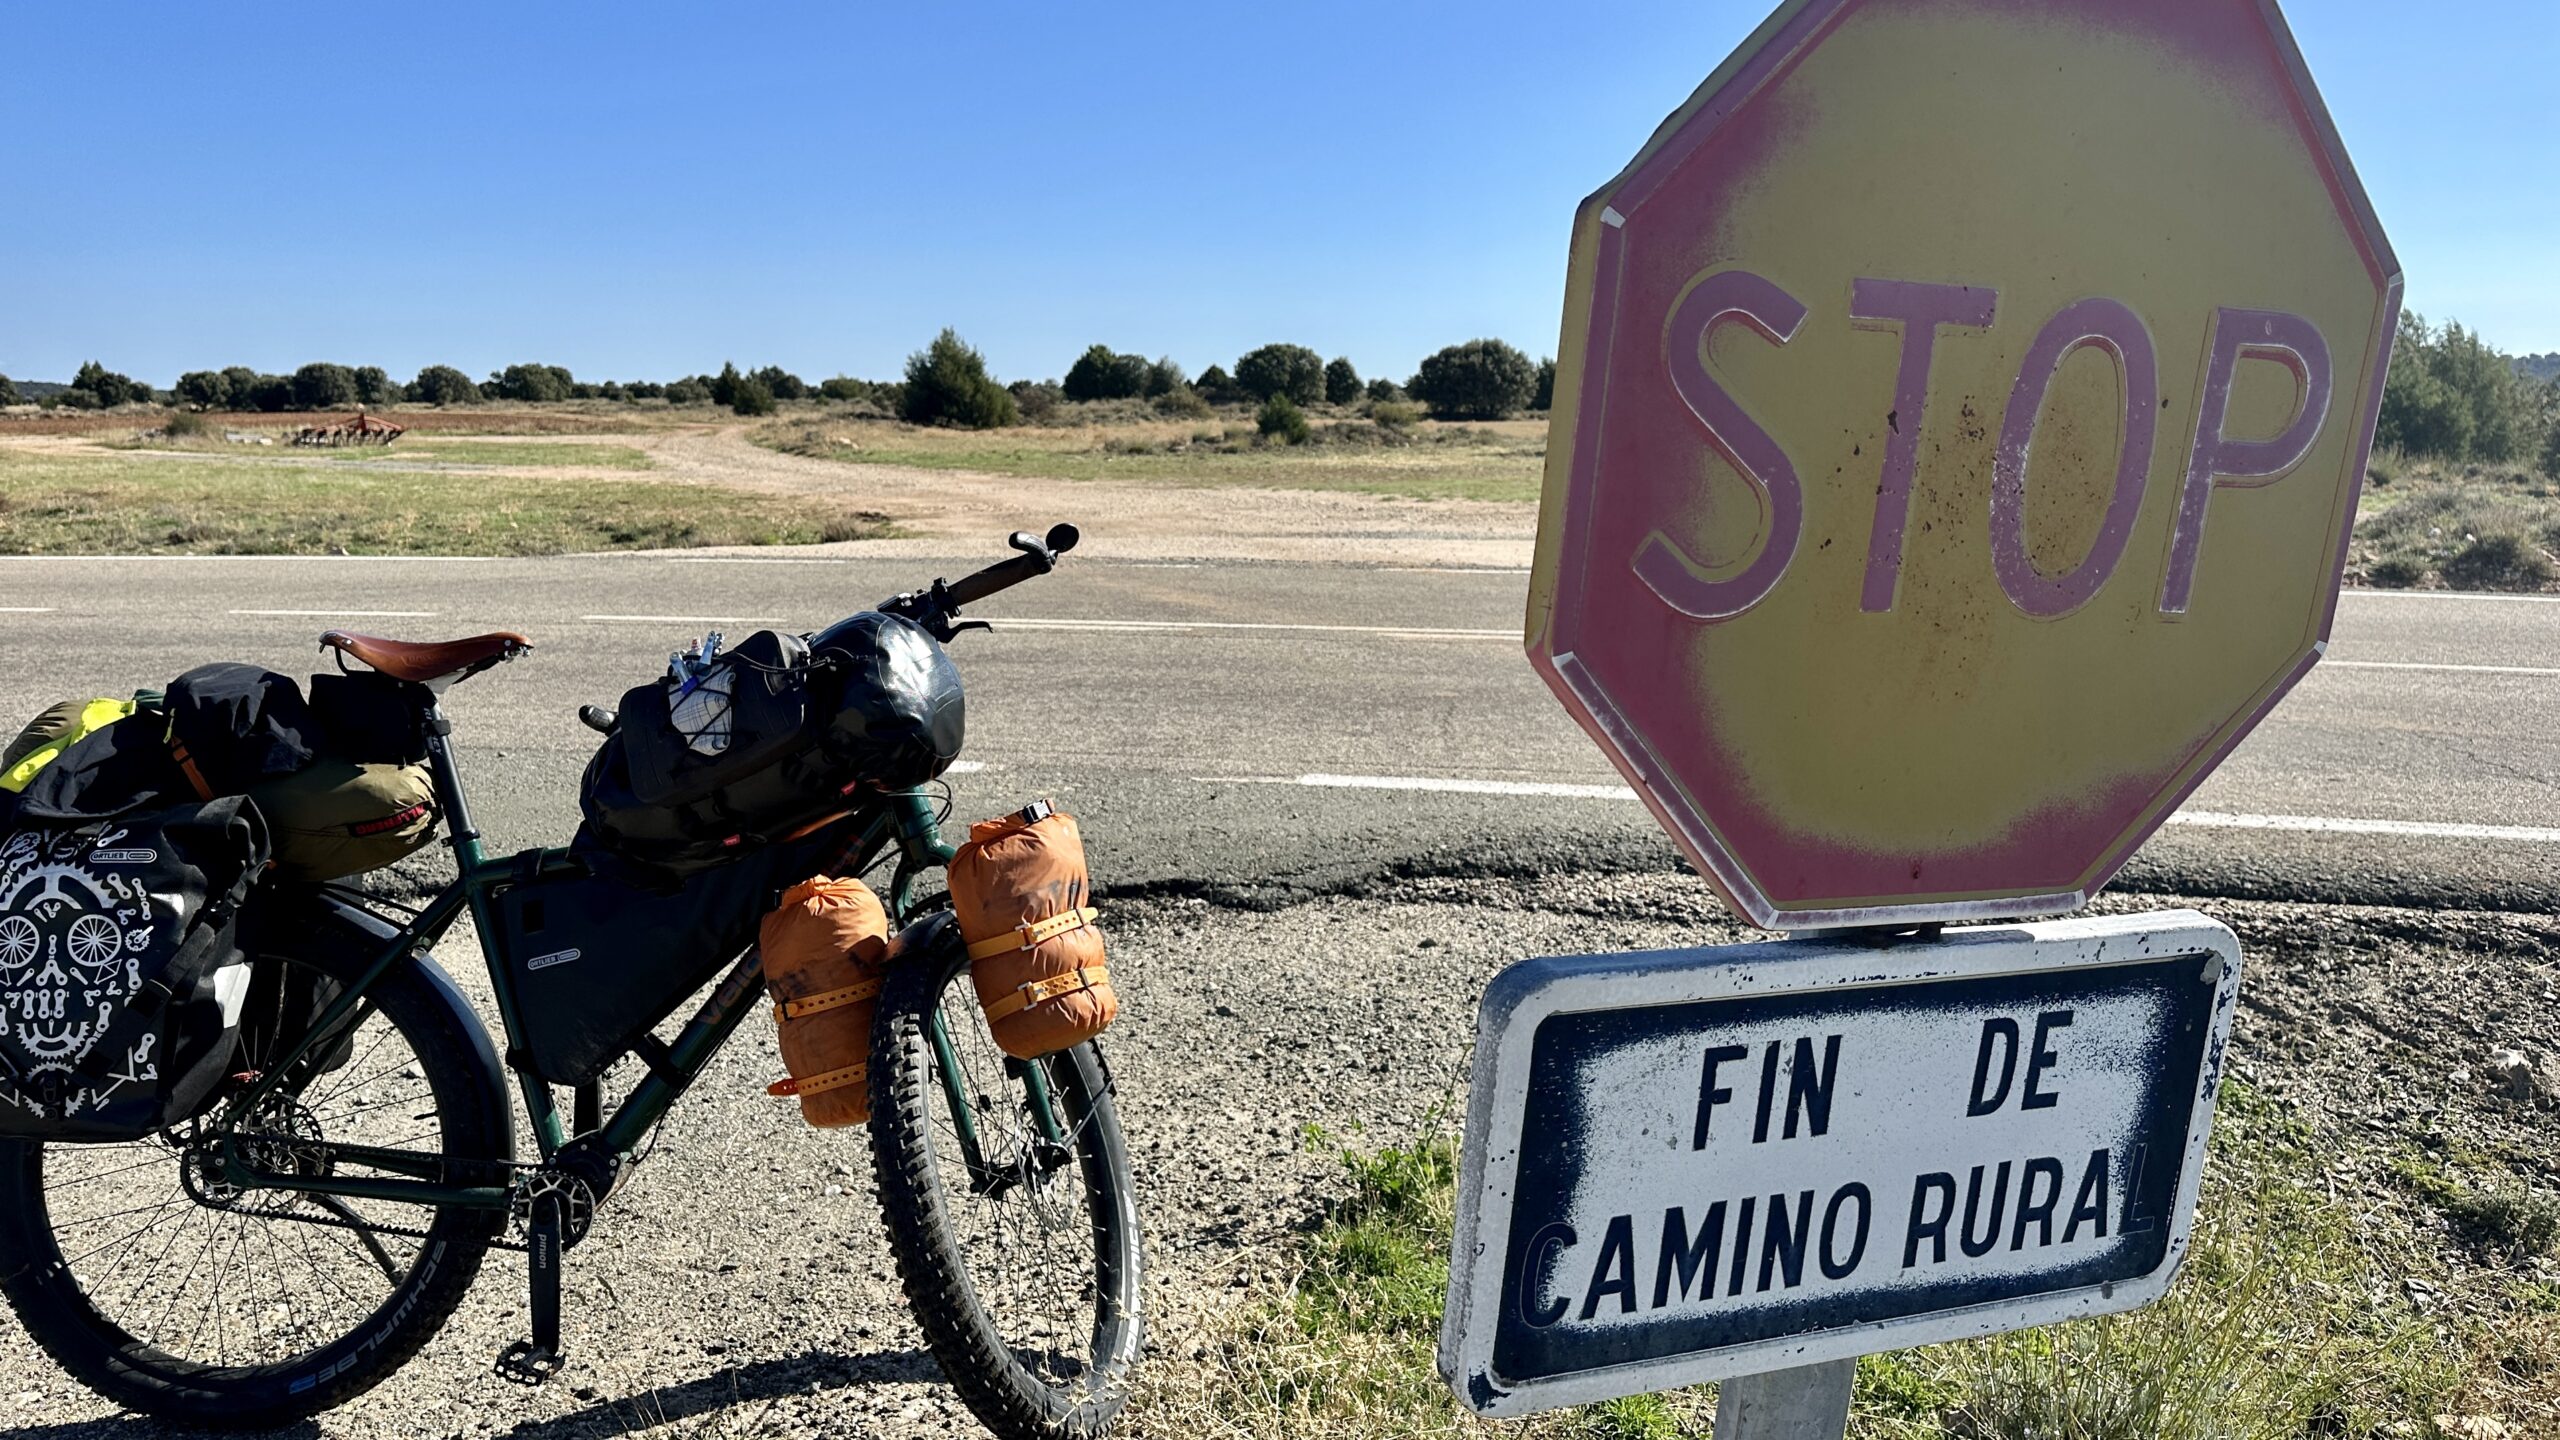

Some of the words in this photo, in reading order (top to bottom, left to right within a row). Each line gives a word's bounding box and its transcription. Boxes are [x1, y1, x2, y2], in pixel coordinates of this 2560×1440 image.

[1633, 269, 2333, 618] STOP
[1692, 1034, 1842, 1151] FIN
[1966, 1010, 2074, 1117] DE
[538, 1233, 547, 1269] pinion
[1520, 1181, 1872, 1328] CAMINO
[1902, 1143, 2155, 1268] RURAL
[318, 1240, 447, 1384] SCHWALBE
